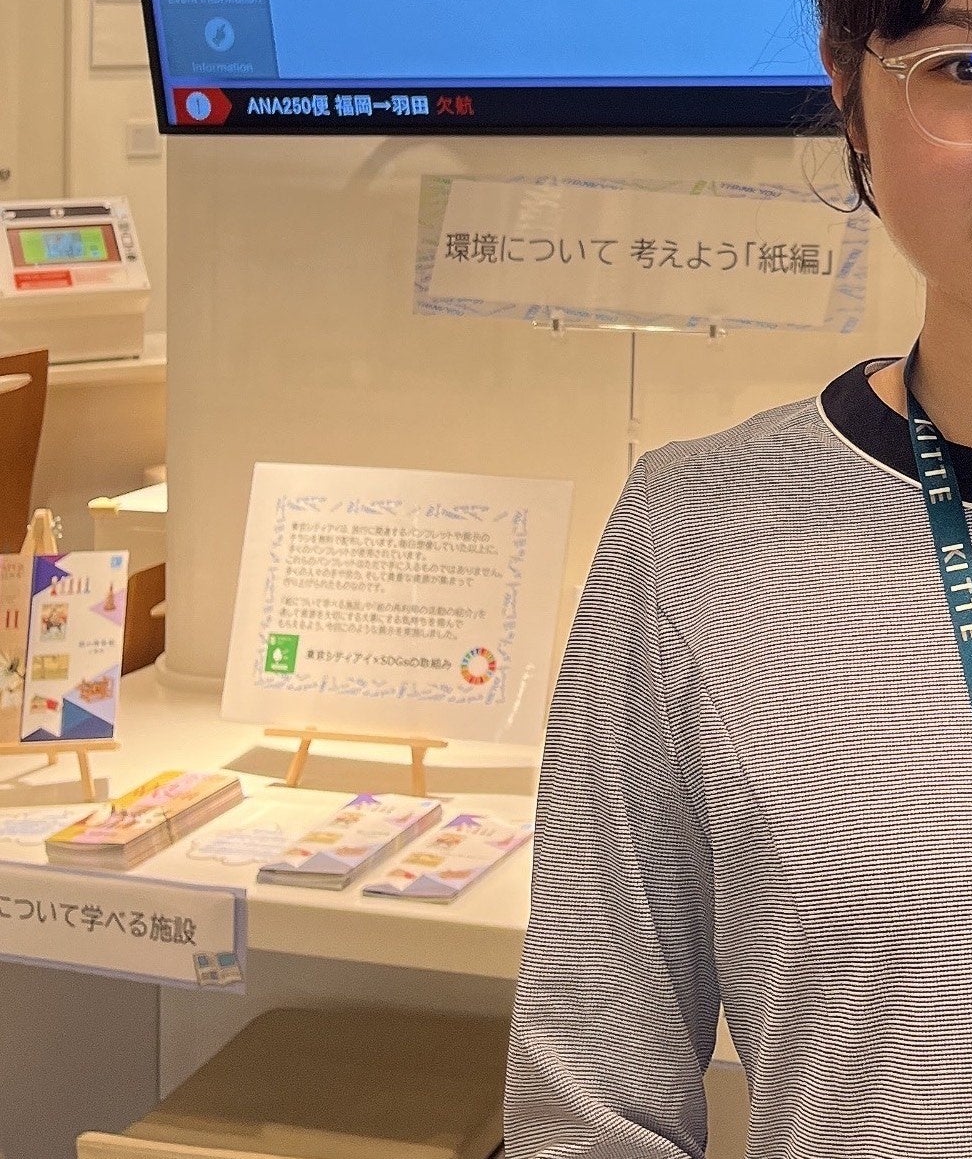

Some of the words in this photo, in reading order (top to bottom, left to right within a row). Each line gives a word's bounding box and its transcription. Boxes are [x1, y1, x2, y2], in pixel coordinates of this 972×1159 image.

[247, 95, 330, 117] ANA250便
[444, 232, 620, 266] 環境について
[630, 237, 834, 277] 考えよう「紙編」
[913, 418, 952, 504] KITTE
